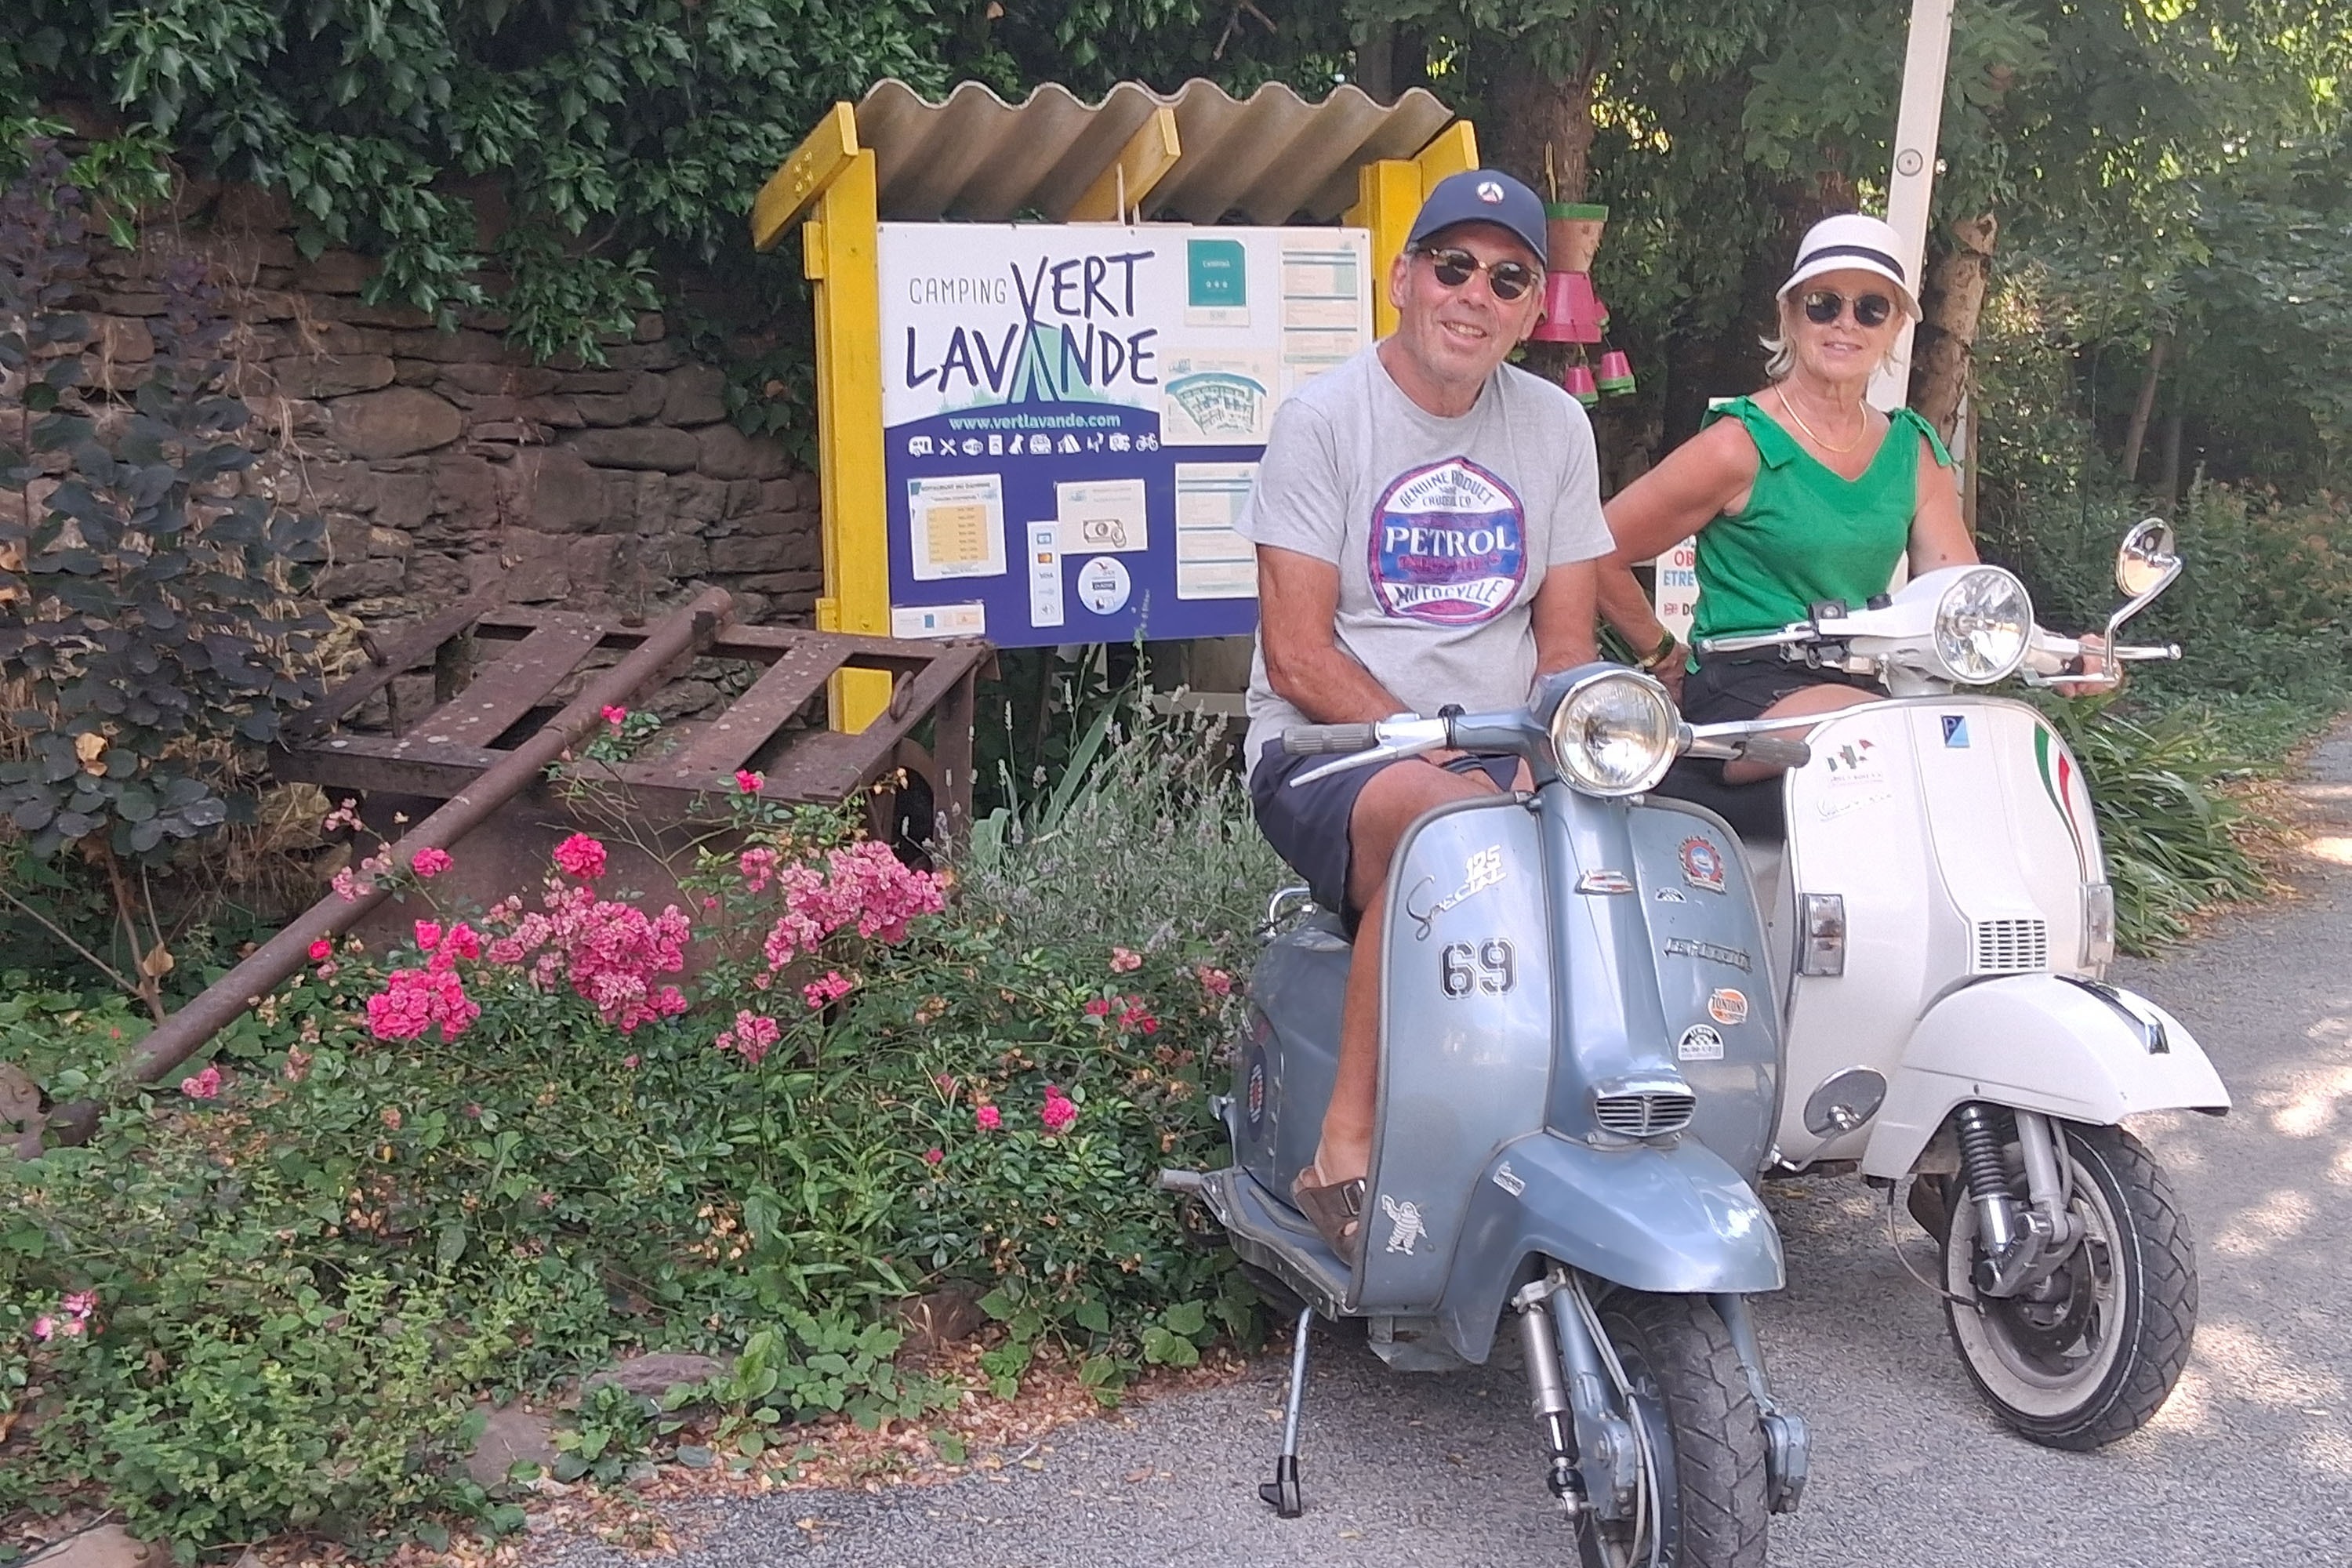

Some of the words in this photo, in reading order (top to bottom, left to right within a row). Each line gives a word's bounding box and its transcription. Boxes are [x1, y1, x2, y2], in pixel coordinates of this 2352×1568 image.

[909, 277, 1007, 306] CAMPING
[1011, 249, 1156, 320] VERT
[906, 318, 1160, 404] LAVANDE
[948, 412, 1121, 430] www.vertlavande.com
[1399, 472, 1450, 508] GENUINE
[1451, 470, 1496, 505] PODUCT
[1385, 525, 1515, 557] PETROL
[1663, 569, 1694, 586] ETRE
[1439, 937, 1517, 1001] 69
